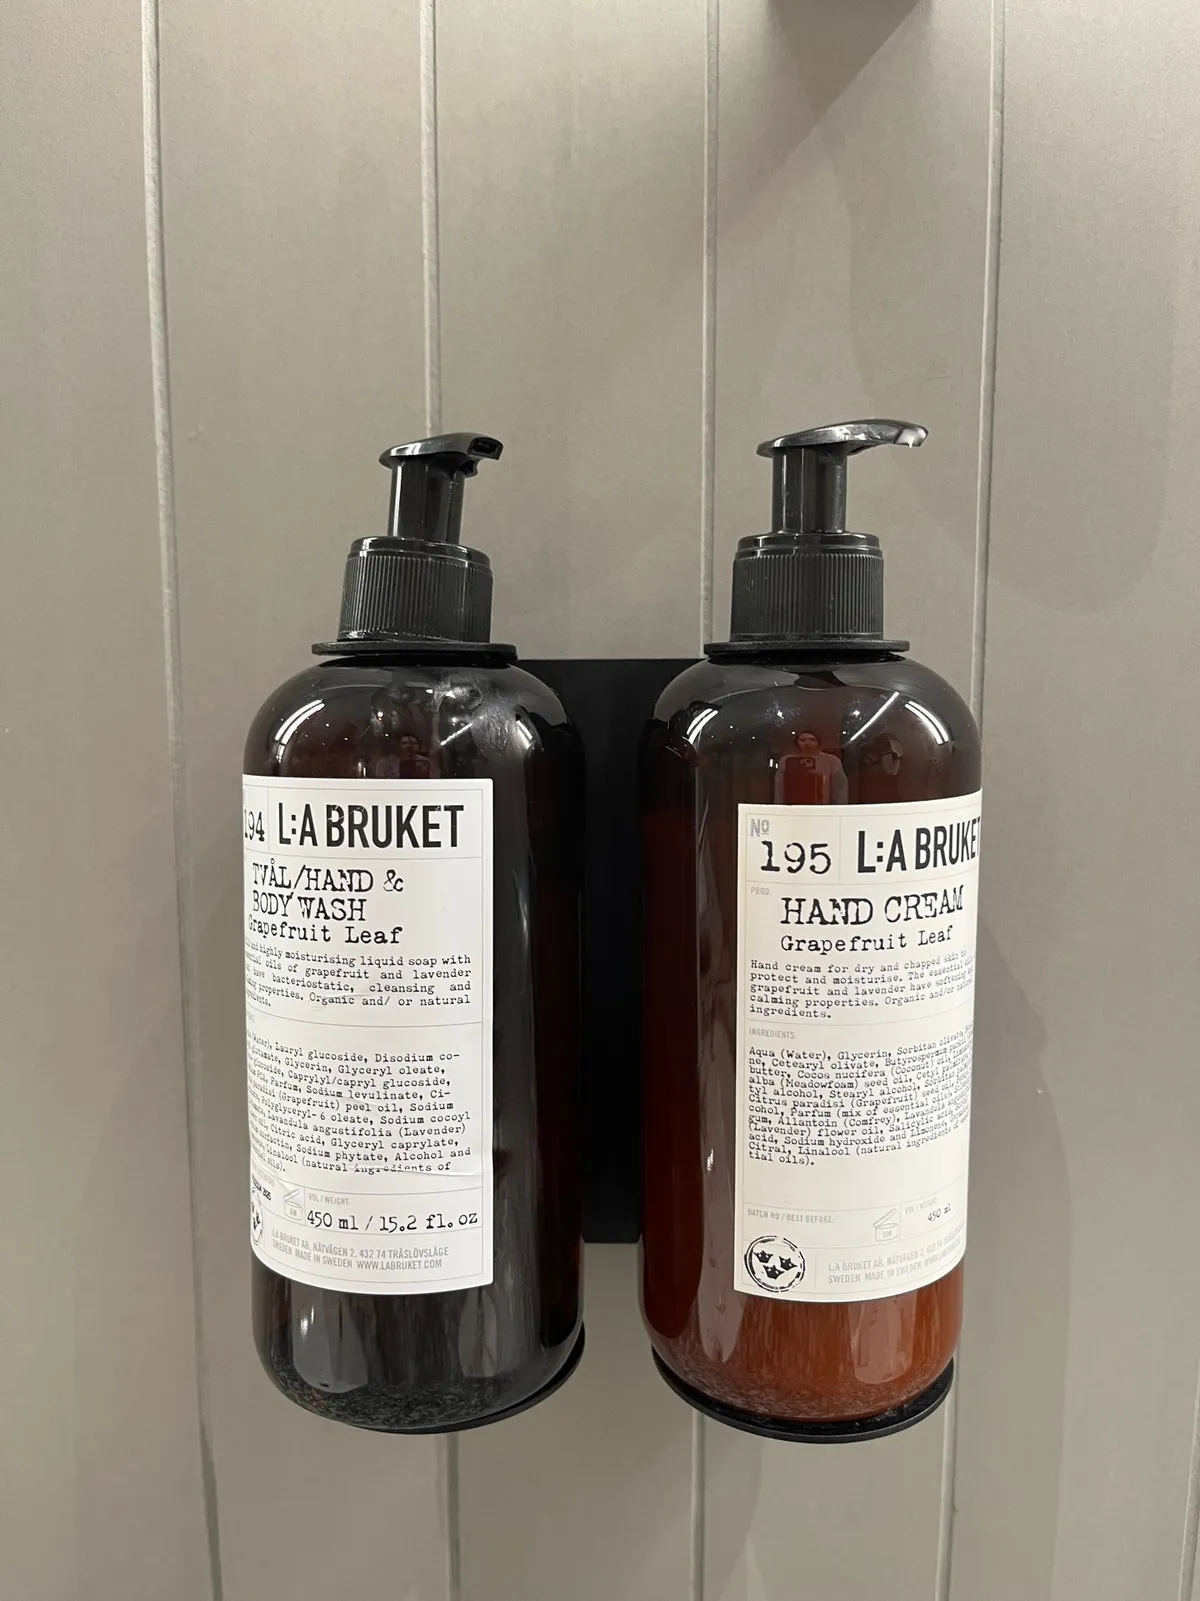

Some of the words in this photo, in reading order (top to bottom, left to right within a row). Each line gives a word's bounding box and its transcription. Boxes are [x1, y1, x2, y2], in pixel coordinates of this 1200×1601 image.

[278, 802, 318, 847] L:A
[326, 804, 464, 849] BRUKET
[760, 840, 832, 874] 195
[857, 829, 907, 874] L:A
[252, 858, 374, 893] TVÅL/HAND
[252, 890, 294, 918] BODY
[297, 896, 367, 922] WASH
[780, 897, 873, 926] HAND
[884, 884, 964, 923] CREAM
[248, 915, 332, 943] Grapefruit
[344, 926, 403, 945] Leaf
[780, 932, 908, 956] Grapefruit
[917, 925, 954, 946] Leaf
[259, 943, 283, 959] highly
[285, 950, 356, 968] moisturising
[360, 955, 404, 969] liquid
[408, 956, 438, 968] soap
[441, 954, 471, 965] with
[751, 960, 779, 971] Hand
[785, 963, 822, 973] cream
[827, 964, 849, 974] for
[854, 963, 874, 975] dry
[880, 962, 899, 972] and
[904, 956, 941, 970] chapped
[265, 959, 282, 971] oils
[305, 966, 370, 981] grapefruit
[380, 968, 403, 980] and
[413, 969, 472, 980] lavender
[750, 972, 799, 984] protect
[805, 975, 827, 985] and
[832, 973, 903, 985] moisturise.
[907, 971, 925, 982] The
[272, 973, 354, 992] bacteriostatic,
[369, 983, 436, 995] cleansing
[449, 981, 471, 992] and
[750, 983, 820, 996] grapefruit
[827, 986, 849, 996] and
[854, 985, 906, 996] lavender
[910, 981, 932, 992] have
[309, 992, 355, 1006] Organic
[361, 995, 391, 1007] and/
[398, 996, 413, 1006] or
[419, 995, 471, 1007] natural
[750, 994, 800, 1007] calming
[805, 998, 879, 1009] properties.
[884, 994, 925, 1007] Organic
[750, 1005, 832, 1019] ingredients.
[275, 1042, 304, 1057] Lauryl
[308, 1050, 368, 1063] glucoside,
[374, 1053, 434, 1063] Disodium
[439, 1052, 460, 1062] co-
[749, 1047, 776, 1059] Aqua
[780, 1049, 831, 1062] (Water),
[837, 1051, 892, 1062] Glycerin,
[896, 1042, 937, 1056] Sorbitan
[284, 1057, 332, 1074] Glycerin,
[337, 1065, 392, 1075] Glyceryl
[399, 1066, 446, 1075] oleate,
[749, 1057, 766, 1066] ne,
[772, 1059, 825, 1071] Cetearyl
[830, 1060, 879, 1070] olivate,
[749, 1066, 791, 1078] butter,
[797, 1070, 830, 1080] Cocos
[835, 1069, 886, 1080] nucifera
[891, 1058, 934, 1076] (Coconut)
[288, 1069, 376, 1088] Caprylyl/capryl
[382, 1079, 451, 1090] glucoside,
[749, 1076, 775, 1087] alba
[780, 1078, 859, 1090] (Meadowfoam)
[864, 1077, 888, 1088] seed
[892, 1073, 913, 1085] oil,
[916, 1067, 939, 1080] Cetyl
[270, 1076, 302, 1093] Parfum,
[306, 1085, 343, 1099] Sodium
[349, 1090, 423, 1101] levulinate,
[429, 1089, 451, 1099] Ci-
[749, 1086, 766, 1096] tyl
[773, 1087, 823, 1099] alcohol,
[829, 1089, 873, 1101] Stearyl
[879, 1083, 921, 1096] alcohol,
[278, 1092, 340, 1111] (Grapefruit)
[346, 1103, 371, 1113] peel
[377, 1104, 403, 1114] oil,
[409, 1101, 454, 1112] Sodium
[748, 1095, 788, 1106] Citrus
[792, 1098, 845, 1110] paradisi
[850, 1092, 919, 1110] (Grapefruit)
[749, 1105, 784, 1116] cohol,
[790, 1108, 831, 1118] Parfum
[836, 1107, 861, 1119] (mix
[883, 1099, 929, 1114] essential
[331, 1114, 374, 1125] oleate,
[380, 1115, 425, 1124] Sodium
[430, 1111, 471, 1124] cocoyl
[778, 1116, 838, 1128] Allantoin
[843, 1114, 900, 1129] (Comfrey),
[270, 1124, 296, 1139] Citric
[299, 1134, 325, 1146] acid,
[331, 1138, 384, 1150] Glyceryl
[390, 1138, 459, 1150] caprylate,
[312, 1123, 392, 1138] angustifolia
[398, 1124, 466, 1138] (Lavender)
[748, 1124, 811, 1138] (Lavender)
[817, 1126, 857, 1137] flower
[861, 1126, 884, 1136] oil,
[748, 1134, 778, 1145] acid,
[784, 1136, 824, 1146] Sodium
[829, 1135, 885, 1148] hydroxide
[890, 1130, 907, 1141] and
[296, 1144, 331, 1158] Sodium
[335, 1150, 389, 1163] phytate,
[394, 1150, 444, 1161] Alcohol
[450, 1147, 471, 1158] and
[749, 1141, 792, 1155] Citral,
[798, 1146, 850, 1156] Linalool
[856, 1141, 902, 1156] (natural
[301, 1157, 348, 1173] (natural
[437, 1161, 452, 1171] of
[749, 1151, 773, 1162] tial
[779, 1154, 815, 1166] oils).
[306, 1210, 333, 1228] 450
[338, 1215, 359, 1231] ml
[379, 1215, 418, 1233] 15.2
[426, 1213, 453, 1229] fl.
[458, 1212, 478, 1226] oz
[927, 1208, 942, 1222] 450
[281, 1232, 300, 1247] BRUKET
[359, 1248, 374, 1258] 432
[294, 1248, 312, 1261] MADE
[322, 1254, 352, 1268] SWEDEN
[356, 1259, 442, 1271] WWW.LABRUKET.COM
[842, 1259, 872, 1271] BRUKET
[828, 1273, 861, 1284] SWEDEN
